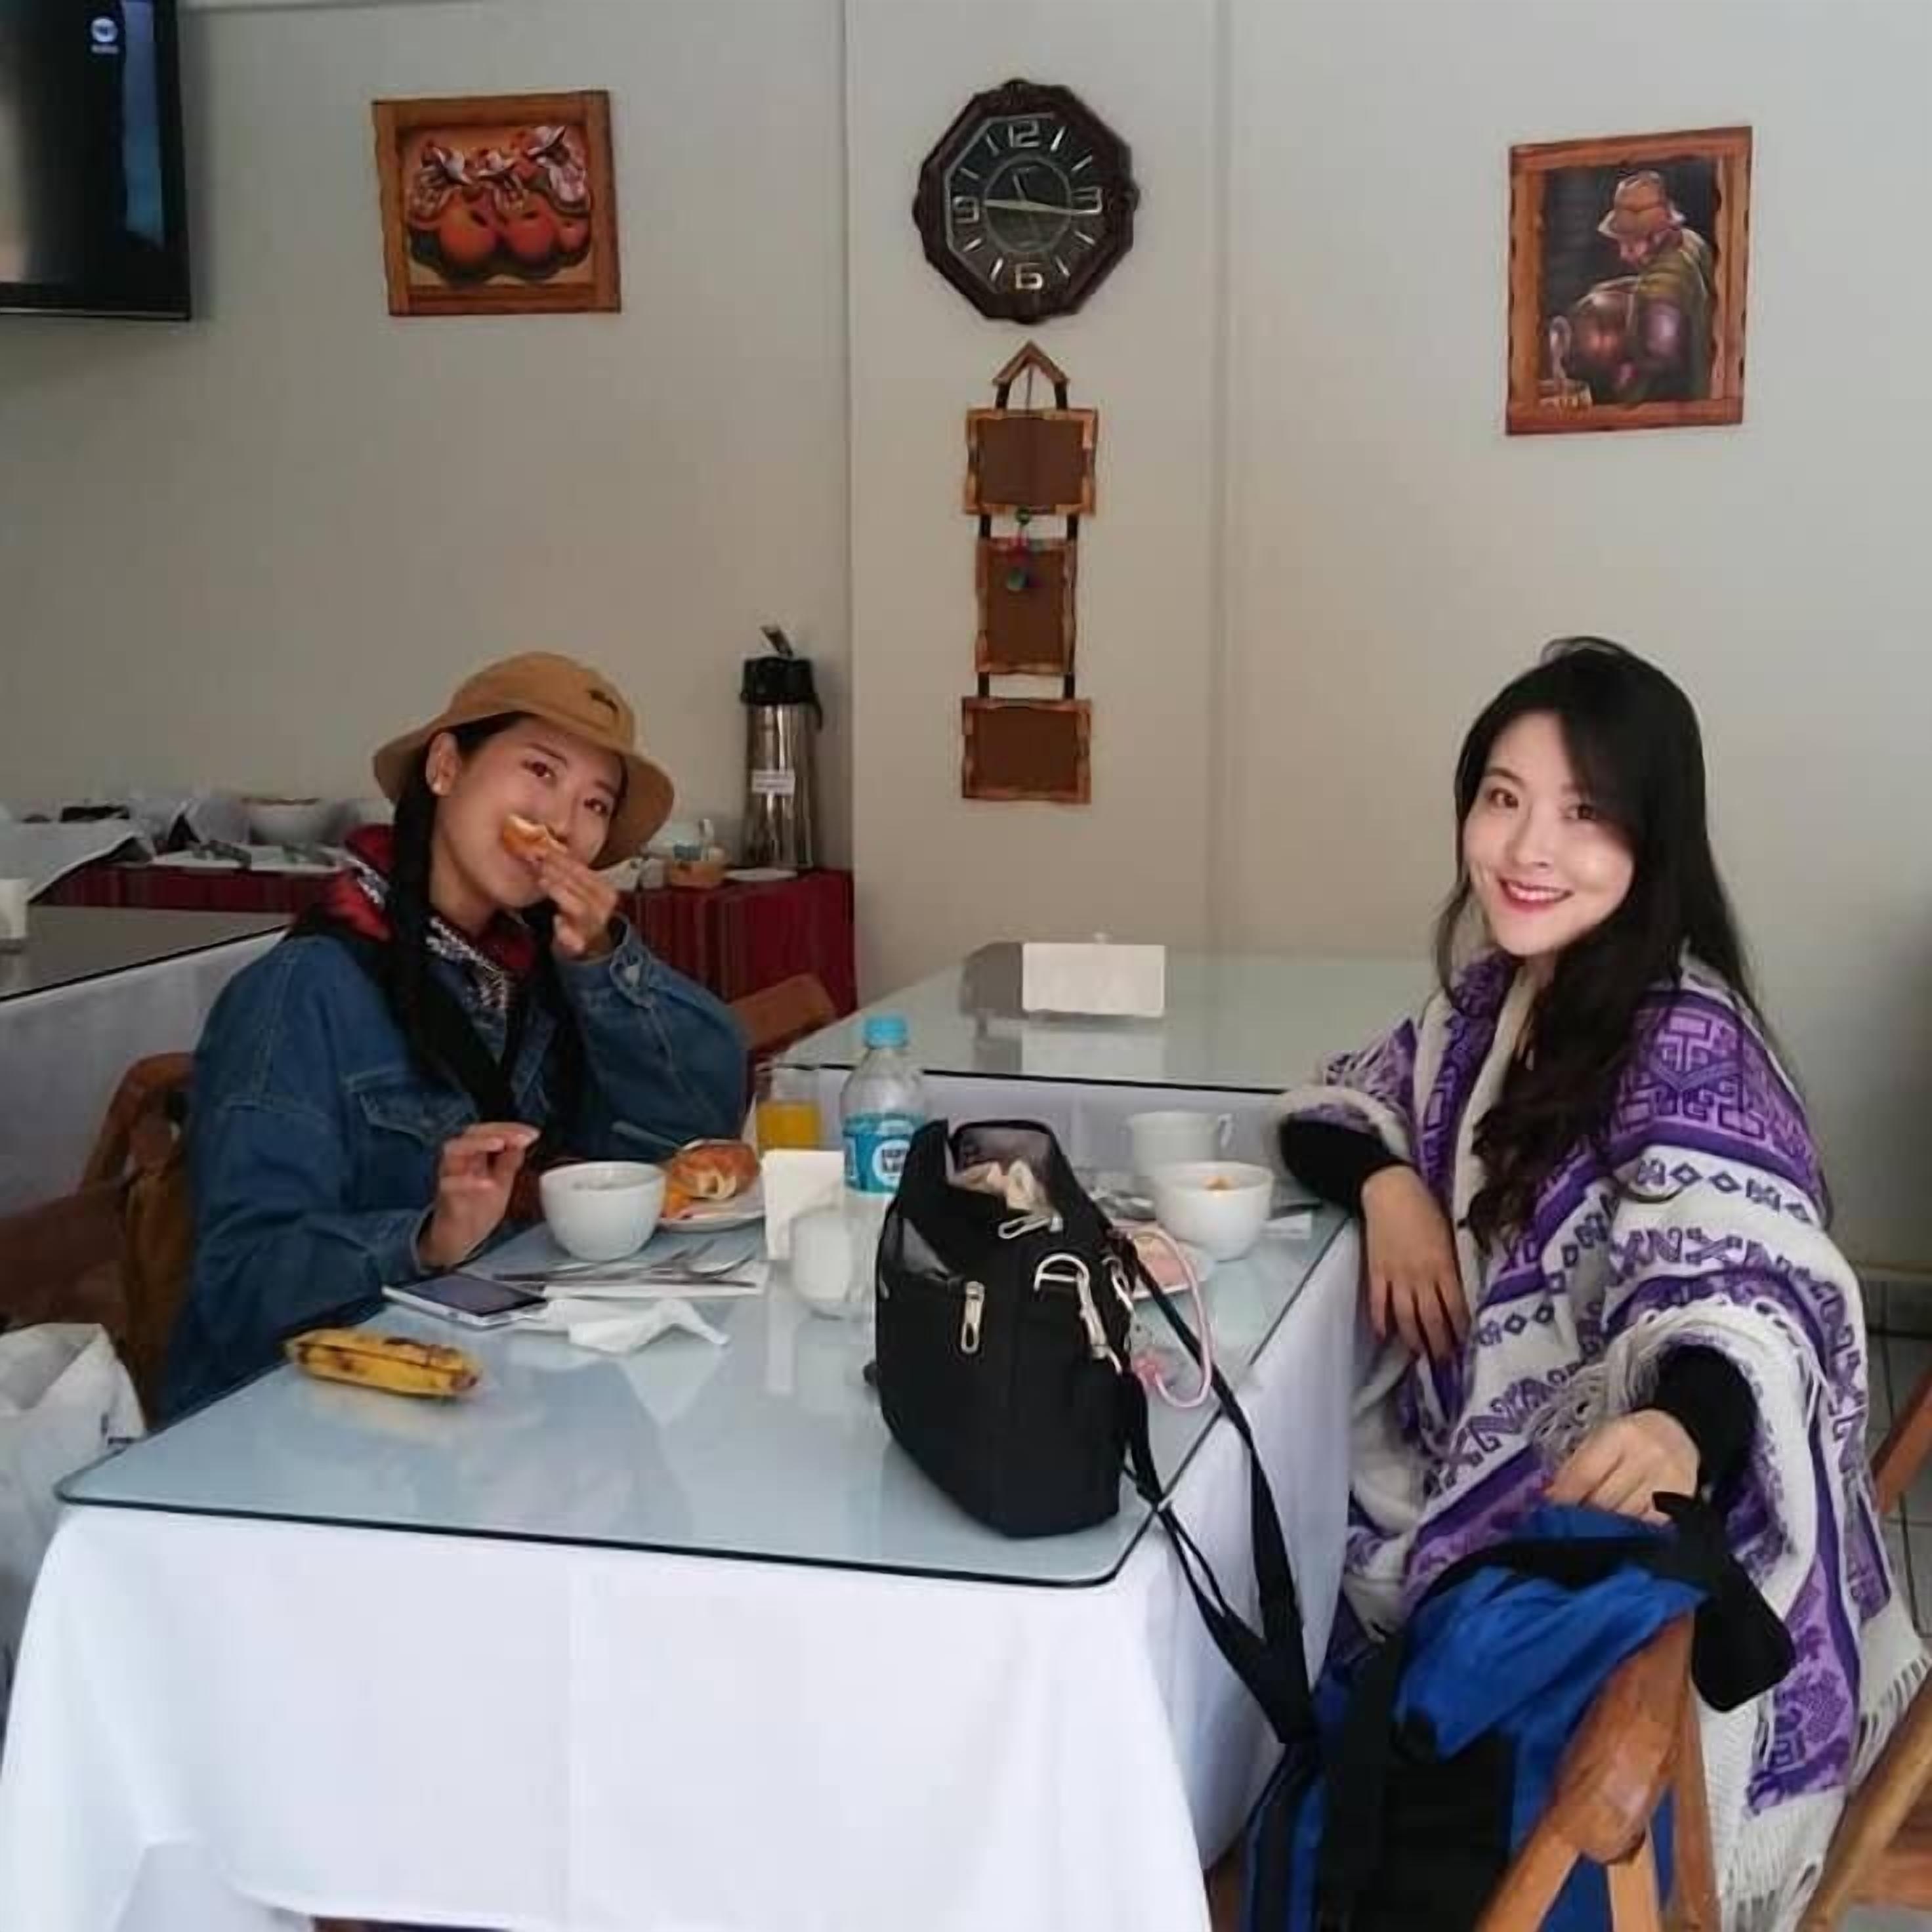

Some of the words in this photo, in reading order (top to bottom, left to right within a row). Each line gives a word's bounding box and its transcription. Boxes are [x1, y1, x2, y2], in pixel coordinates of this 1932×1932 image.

[1008, 121, 1040, 148] 12
[953, 196, 979, 223] 9
[1015, 264, 1043, 289] 6
